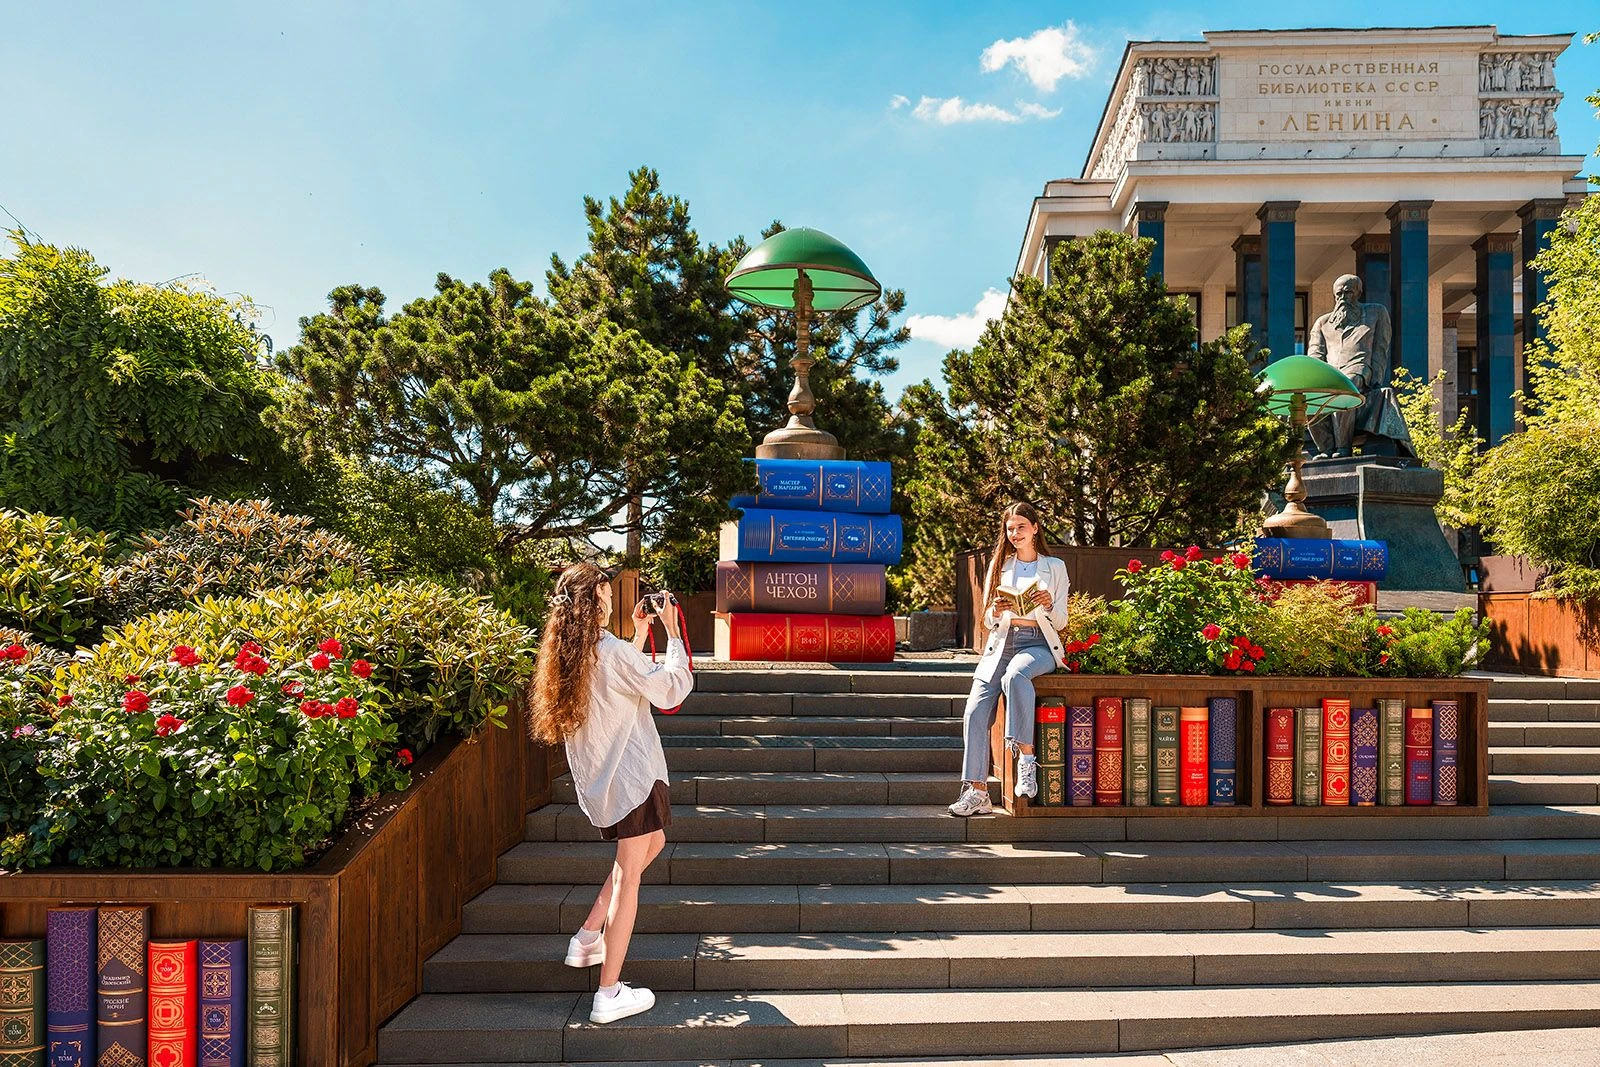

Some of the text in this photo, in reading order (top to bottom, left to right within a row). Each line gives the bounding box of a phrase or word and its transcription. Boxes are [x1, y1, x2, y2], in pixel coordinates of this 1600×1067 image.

[1258, 62, 1439, 76] ГОСУДАРСТВЕННАЯ
[1258, 81, 1377, 94] БИБЛИОТЕКА
[1324, 99, 1372, 107] ИМЕНИ
[1282, 112, 1414, 131] ЛЕНИНА
[765, 572, 818, 586] АНТОН
[766, 586, 817, 599] ЧЕХОВ
[800, 636, 817, 645] 1848
